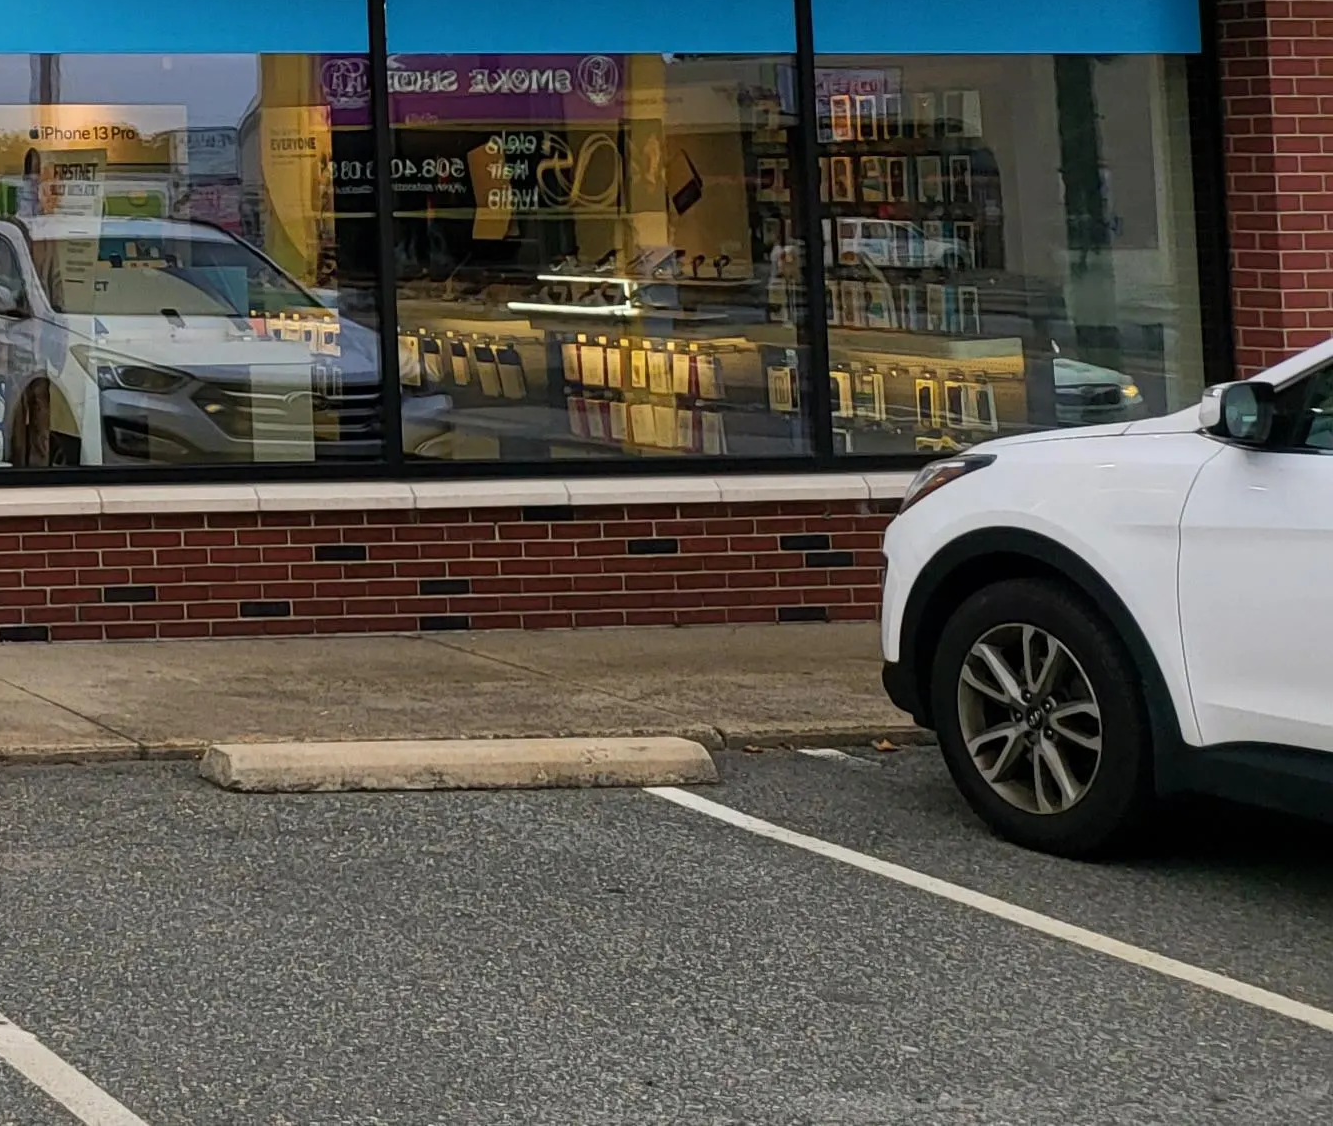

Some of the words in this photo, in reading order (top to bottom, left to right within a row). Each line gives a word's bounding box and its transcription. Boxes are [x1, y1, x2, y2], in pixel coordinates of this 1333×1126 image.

[41, 126, 90, 140] iPhone
[92, 126, 108, 140] 13
[111, 126, 135, 140] Pro
